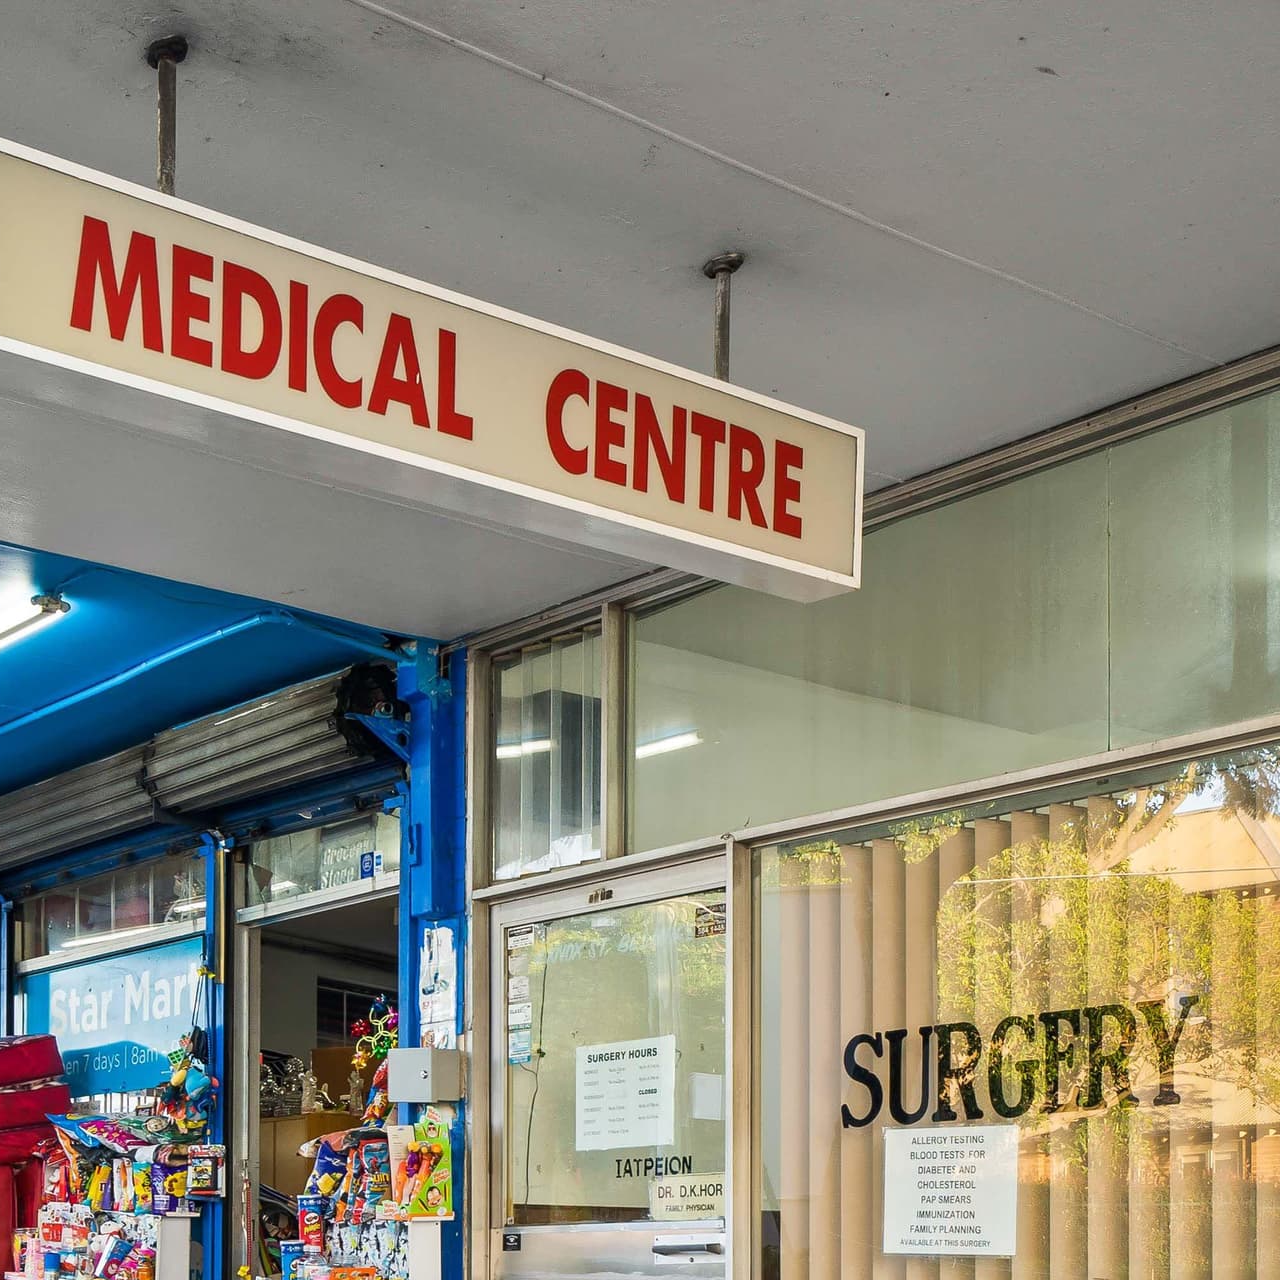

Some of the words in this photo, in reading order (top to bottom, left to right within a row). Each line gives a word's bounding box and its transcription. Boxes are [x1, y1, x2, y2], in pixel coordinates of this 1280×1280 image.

[69, 215, 474, 441] MEDICAL
[545, 367, 804, 540] CENTRE
[51, 987, 112, 1038] Star
[124, 962, 200, 1025] Mart
[83, 1054, 90, 1072] 7
[93, 1051, 120, 1073] days
[131, 1046, 158, 1065] 8am
[587, 1051, 626, 1064] SURGERY
[628, 1047, 658, 1060] HOURS
[841, 995, 1198, 1129] SURGERY
[912, 1136, 947, 1145] ALLERGY
[949, 1135, 984, 1144] TESTING
[910, 1151, 938, 1160] BLOOD
[940, 1150, 964, 1159] TESTS
[968, 1150, 985, 1159] FOR
[917, 1165, 956, 1174] DIABETES
[959, 1164, 976, 1174] AND
[917, 1180, 976, 1189] CHOLESTEROL
[657, 1186, 675, 1199] DR.
[921, 1195, 936, 1204] PAP
[938, 1195, 971, 1204] SMEARS
[665, 1205, 684, 1213] FAMILY
[685, 1203, 715, 1212] PHYSICIAN
[916, 1210, 975, 1219] IMMUNIZATION
[909, 1225, 938, 1233] FAMILY
[939, 1225, 981, 1234] PLANNING
[900, 1239, 933, 1247] AVAILABLE
[944, 1239, 959, 1247] THIS
